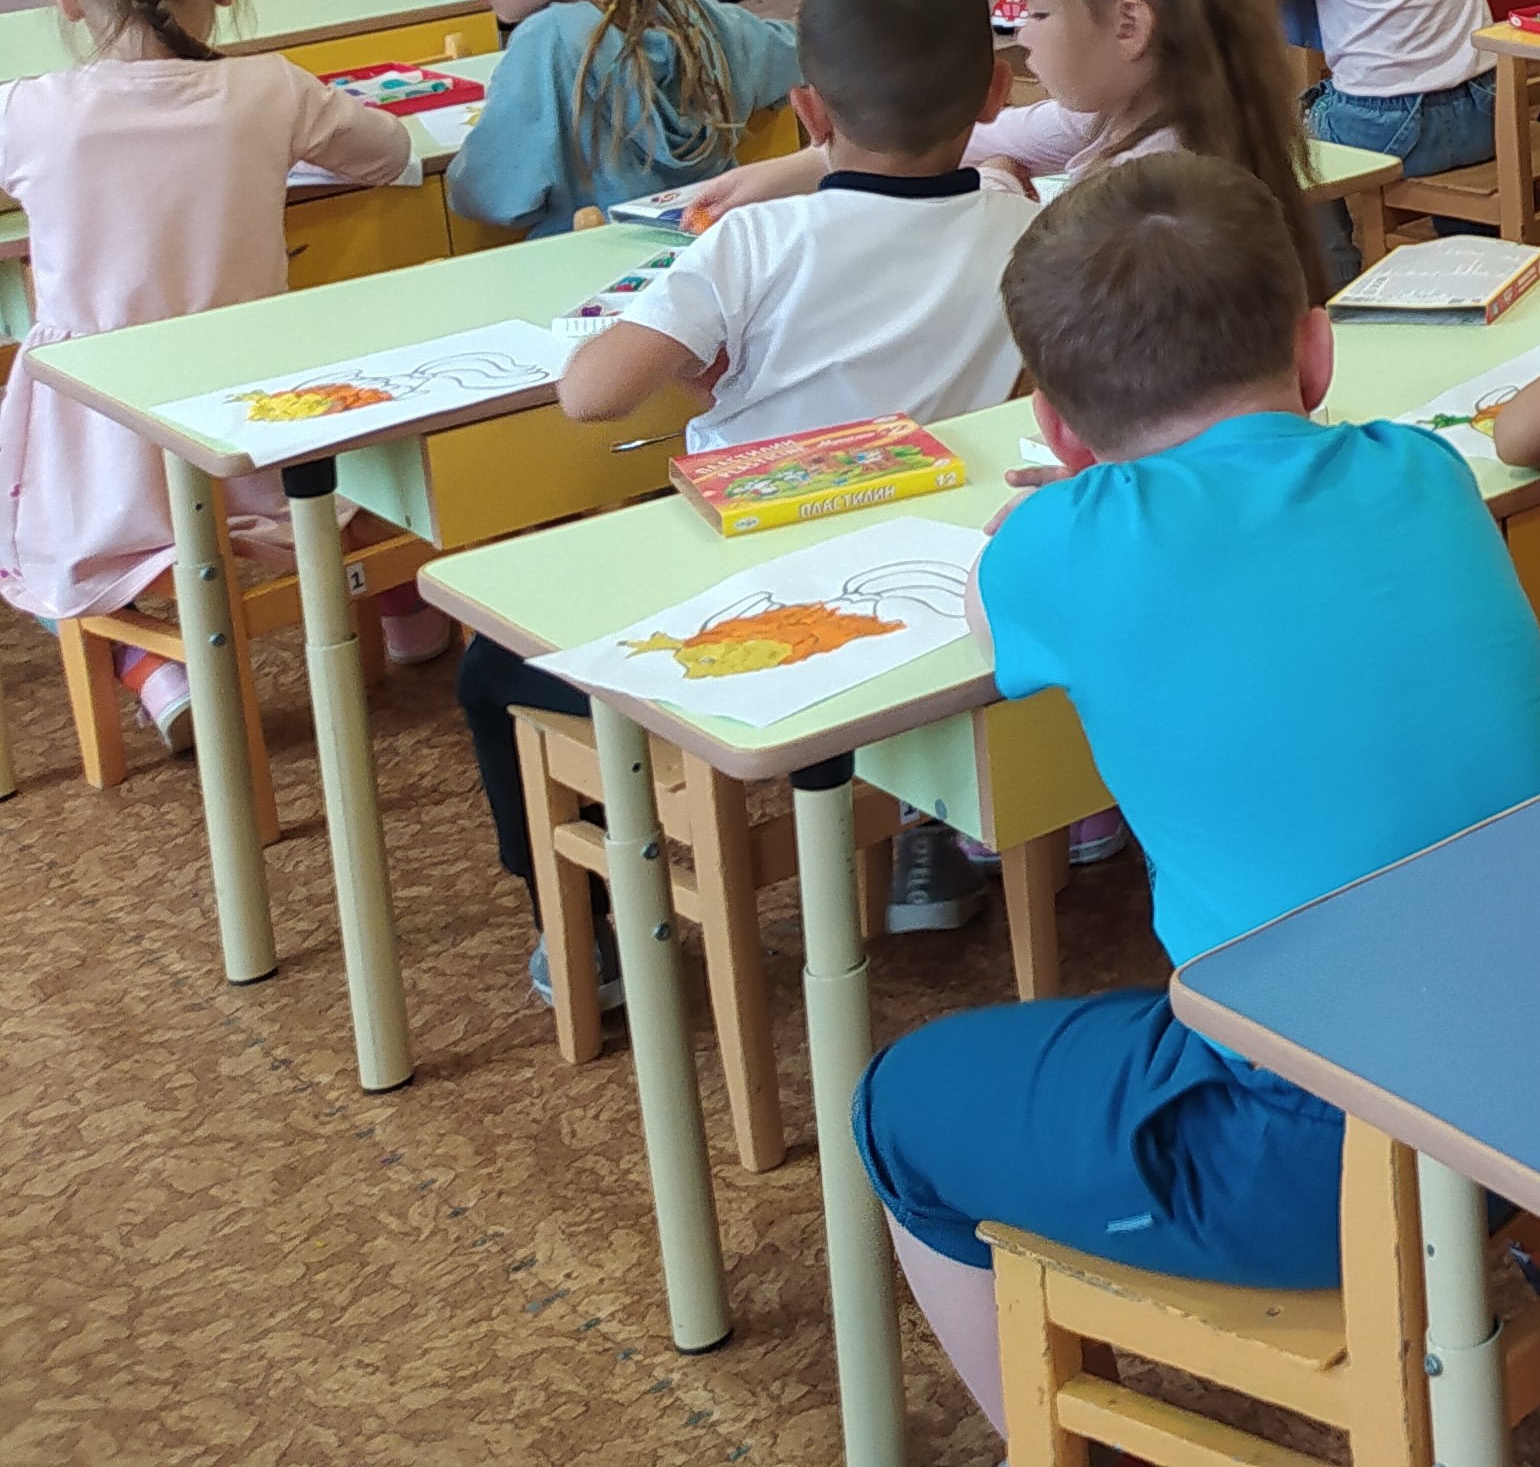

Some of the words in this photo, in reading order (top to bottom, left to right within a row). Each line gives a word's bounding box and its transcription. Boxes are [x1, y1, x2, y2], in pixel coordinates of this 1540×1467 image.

[695, 439, 797, 475] ПЛАСТИЛИН
[936, 472, 957, 487] 12
[799, 486, 896, 518] ПЛАСТИЛИН
[351, 571, 364, 590] 1
